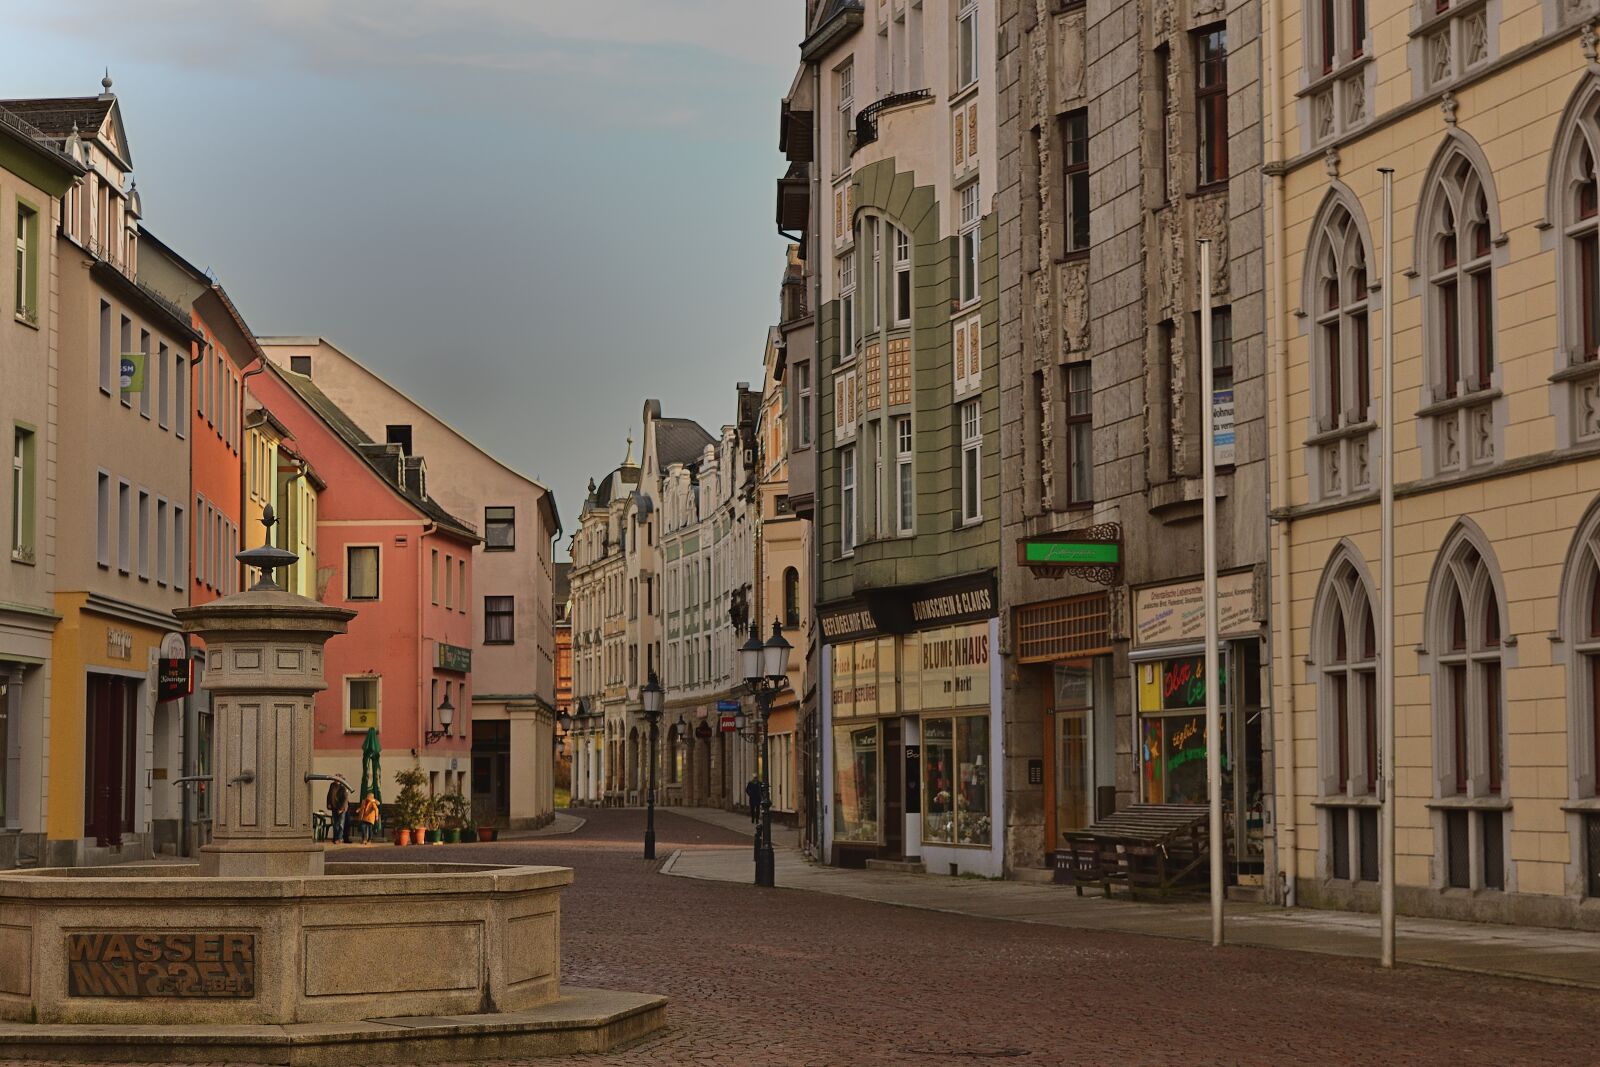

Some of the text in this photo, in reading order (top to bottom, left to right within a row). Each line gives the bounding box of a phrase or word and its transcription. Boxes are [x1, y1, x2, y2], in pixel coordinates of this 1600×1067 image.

[912, 588, 992, 621] BORNSCHEIN & CLAUSS
[822, 613, 861, 636] GEFLÜGELHOF
[923, 634, 988, 670] BLUMENHAUS
[944, 675, 972, 693] am Markt
[833, 689, 843, 705] EIER
[69, 934, 254, 961] WASSER
